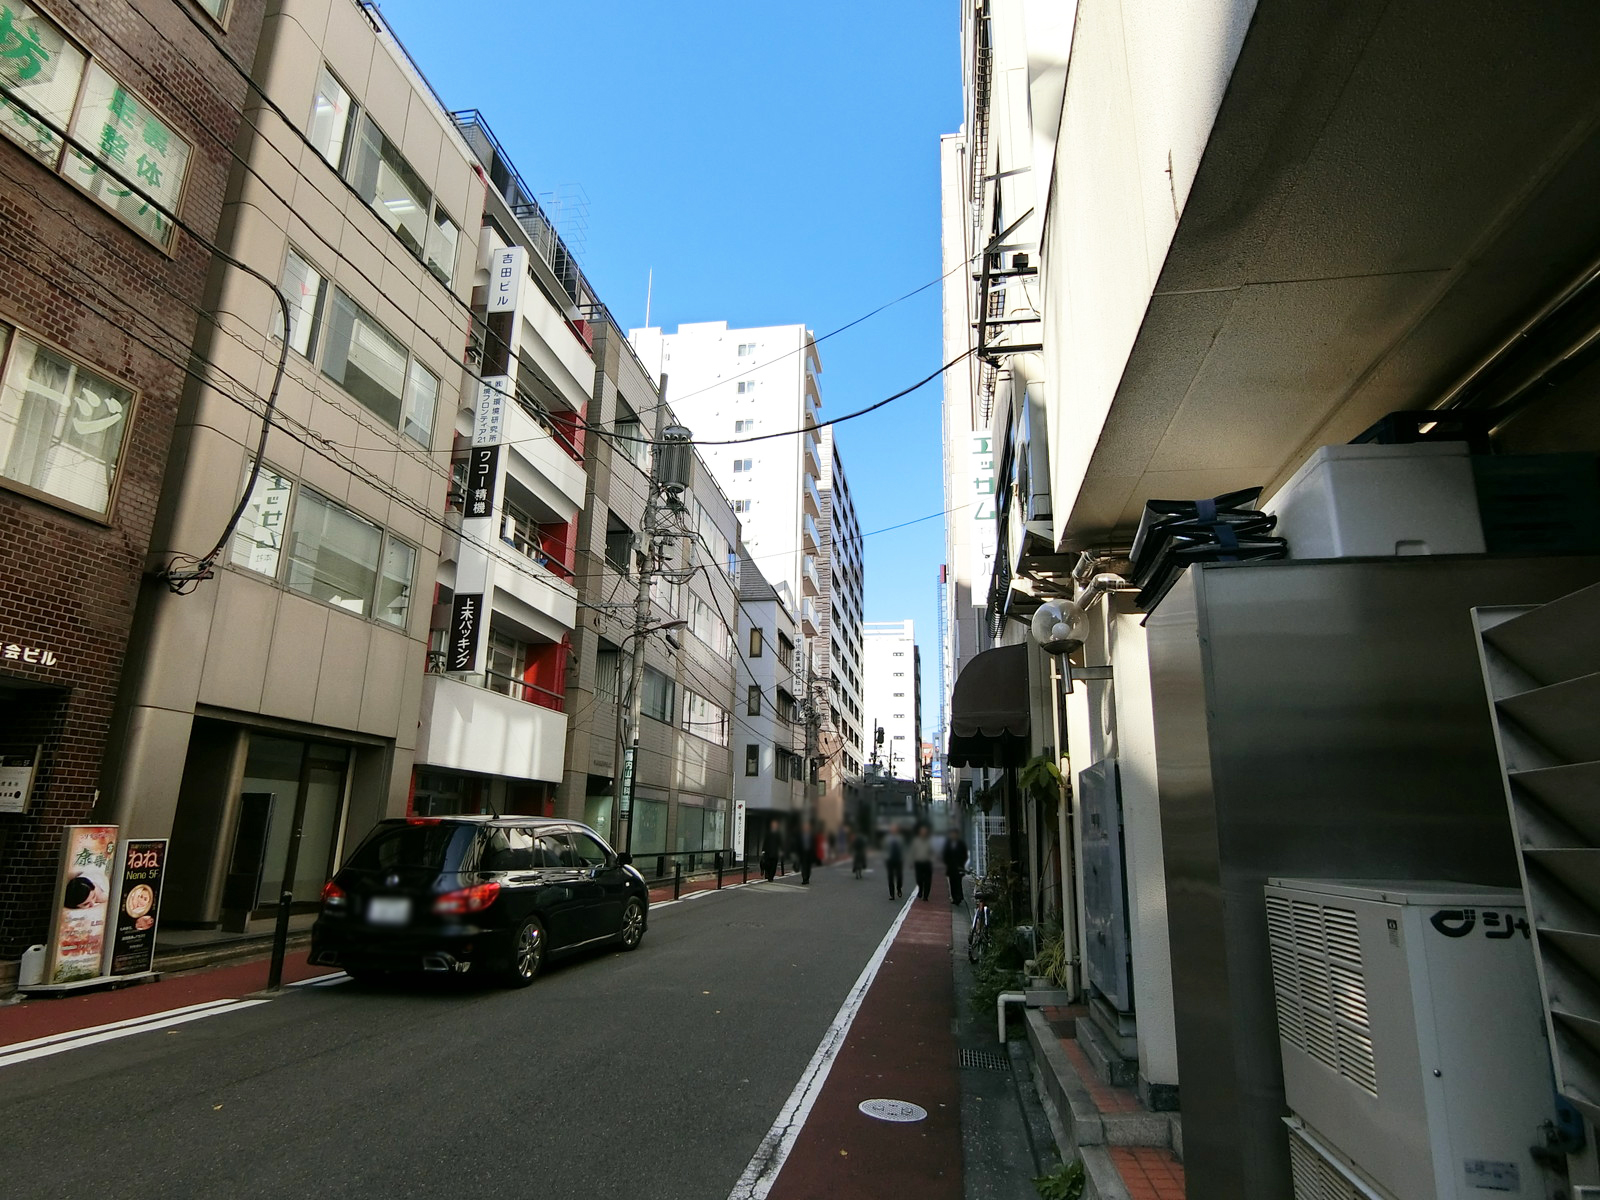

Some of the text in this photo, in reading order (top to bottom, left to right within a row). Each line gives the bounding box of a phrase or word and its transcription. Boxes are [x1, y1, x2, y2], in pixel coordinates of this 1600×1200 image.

[98, 121, 163, 187] 整体
[496, 253, 514, 306] 吉田ビル
[472, 450, 491, 514] ワコー精機
[0, 641, 57, 667] 会ビル
[456, 597, 475, 669] 上木パッキング
[126, 868, 160, 880] Nene 5F
[128, 850, 159, 869] ねね
